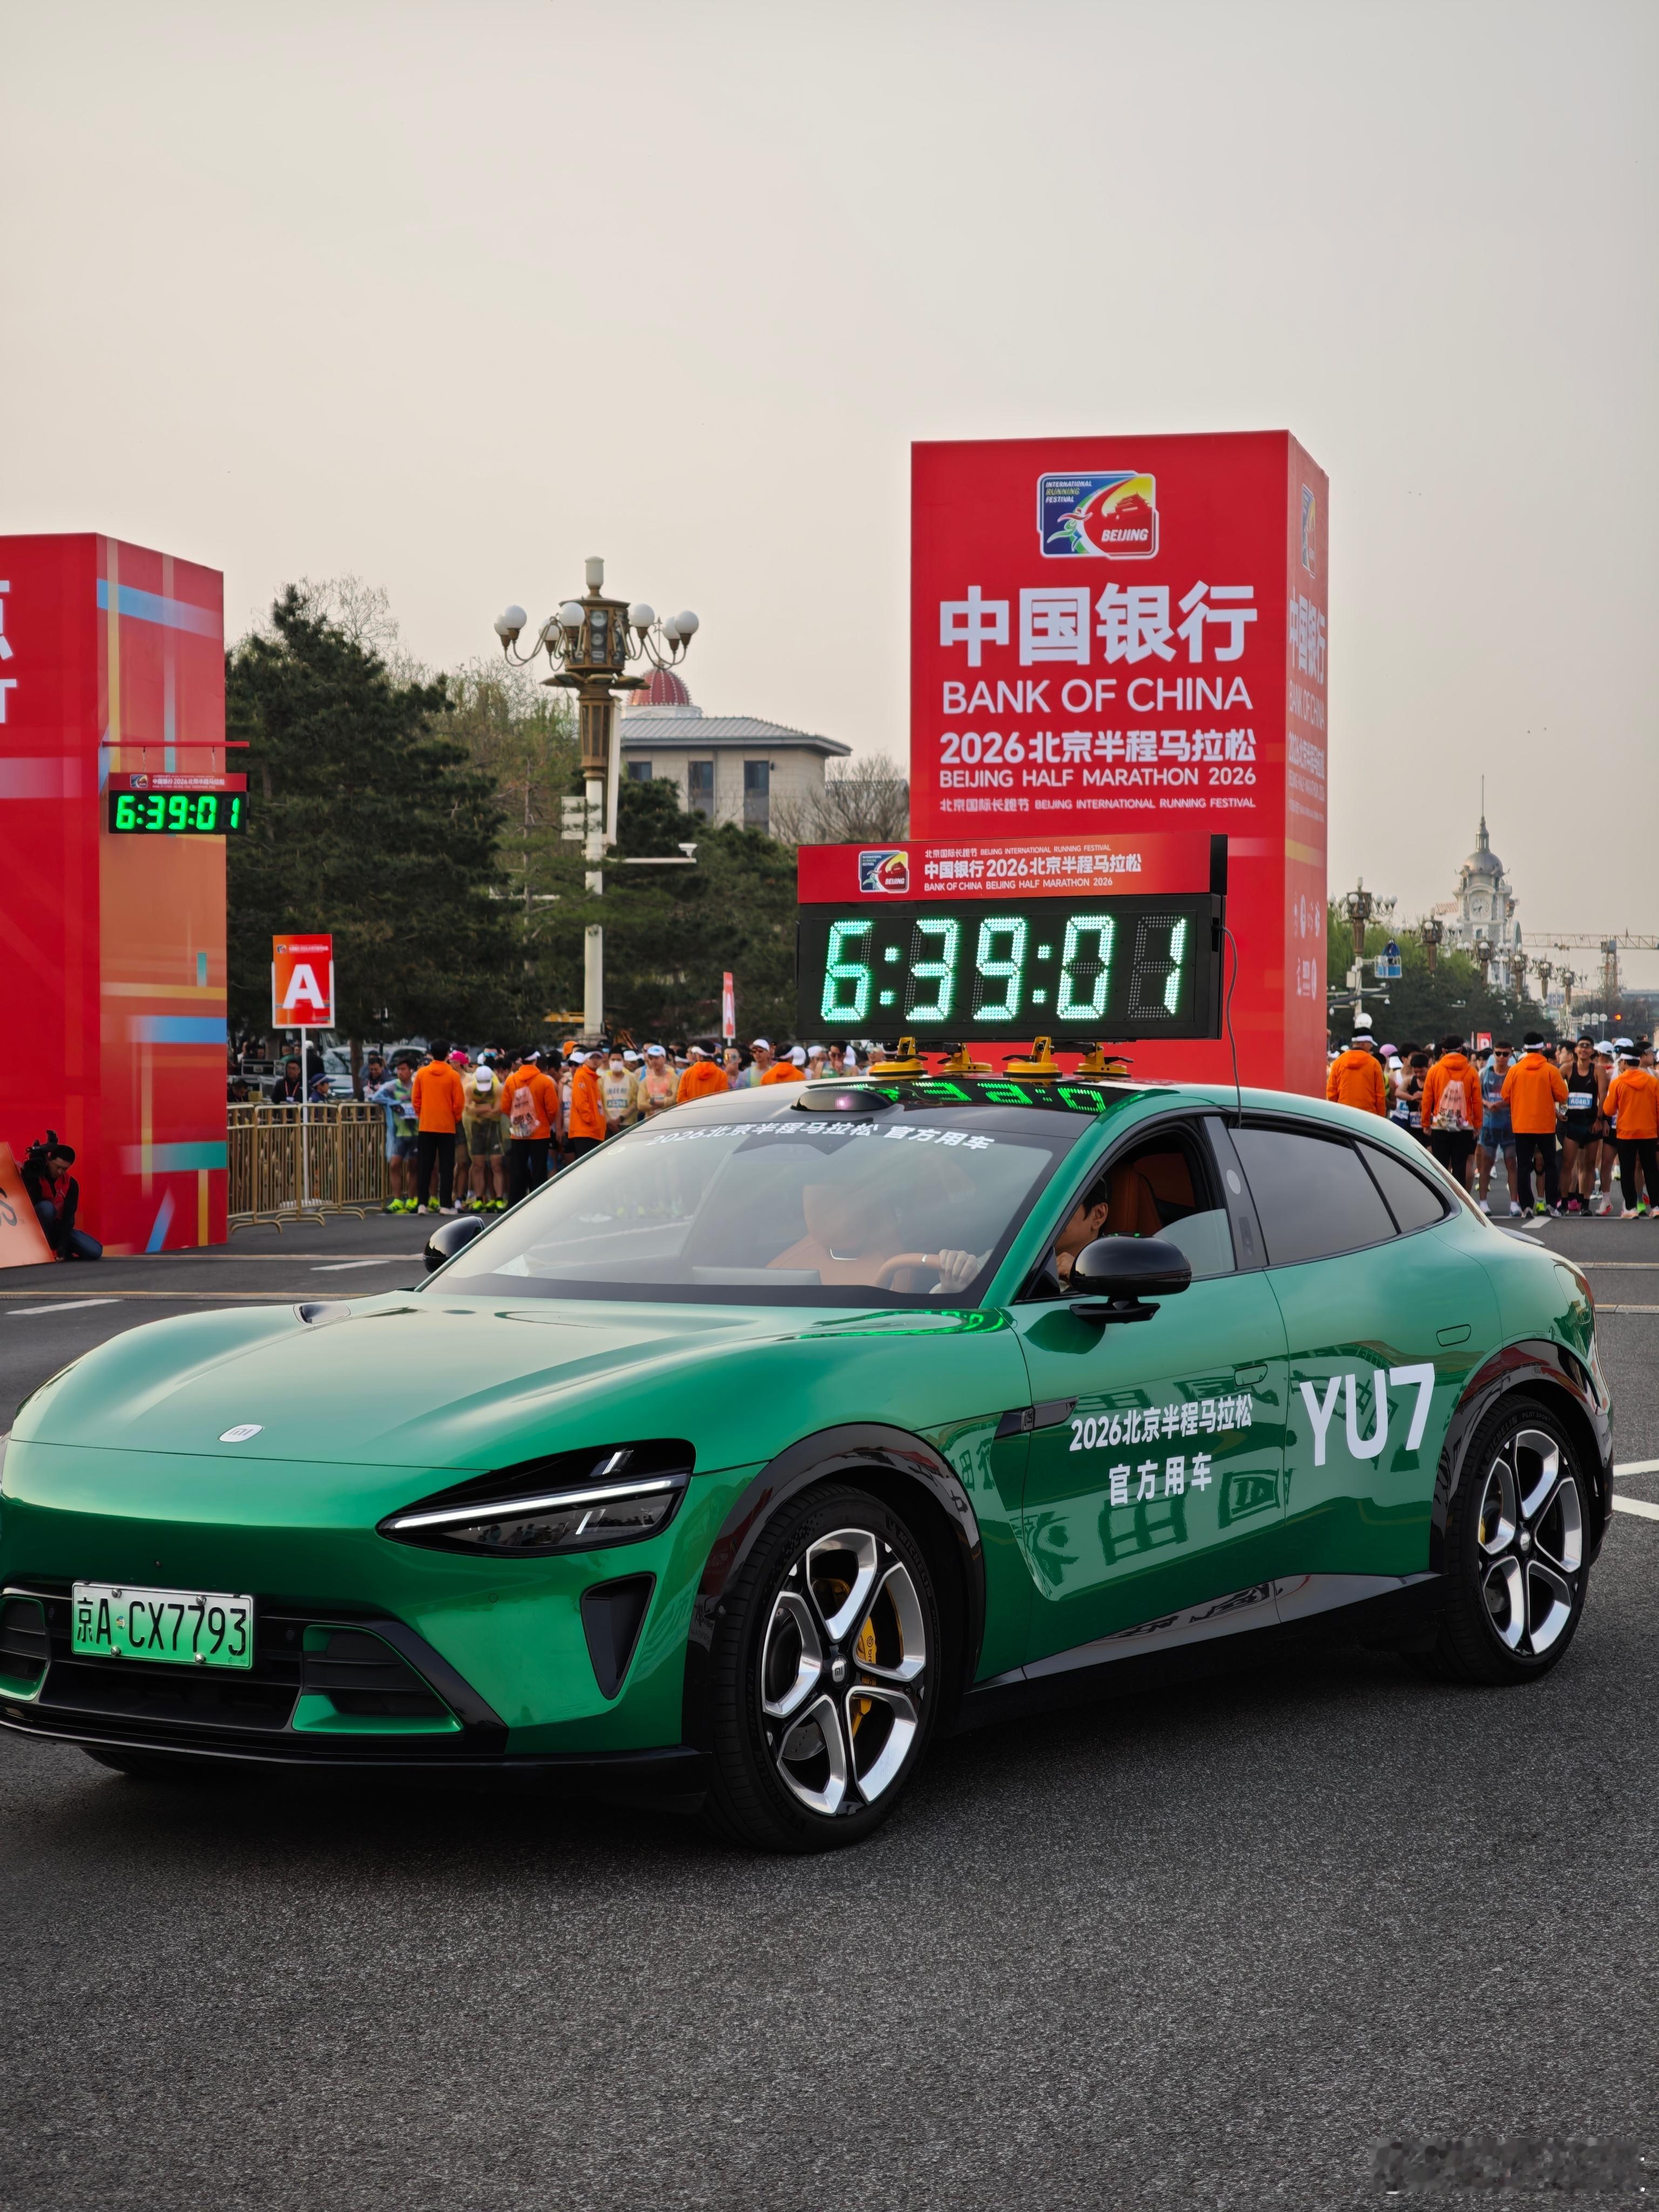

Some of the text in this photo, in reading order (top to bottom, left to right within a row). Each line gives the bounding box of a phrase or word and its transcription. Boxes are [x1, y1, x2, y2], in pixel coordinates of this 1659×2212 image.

[1102, 528, 1149, 542] BEIJING
[940, 580, 1257, 667] 中国银行
[943, 676, 1254, 714] BANK OF CHINA
[940, 767, 1256, 788] BEIJING HALF MARATHON 2026
[116, 795, 240, 830] 6:39:01
[940, 797, 1256, 812] 北京国际长跑节 BEIJING INTERNATIONAL RUNNING FESTIVAL
[925, 848, 977, 859] 北京国际长跑节
[980, 848, 1003, 856] BEIJING
[1004, 846, 1051, 855] INTERNATIONAL
[924, 877, 1112, 892] BANK OF CHINA BEIJING HALF MARATHON 2026
[282, 964, 325, 1009] A
[821, 915, 1187, 1022] 6:39:01
[645, 1123, 995, 1150] 2026北京半程马拉松 官方用车
[1069, 1393, 1252, 1452] 2026北京半程马拉松
[1300, 1363, 1435, 1467] YU7
[1108, 1452, 1212, 1506] 官方用车
